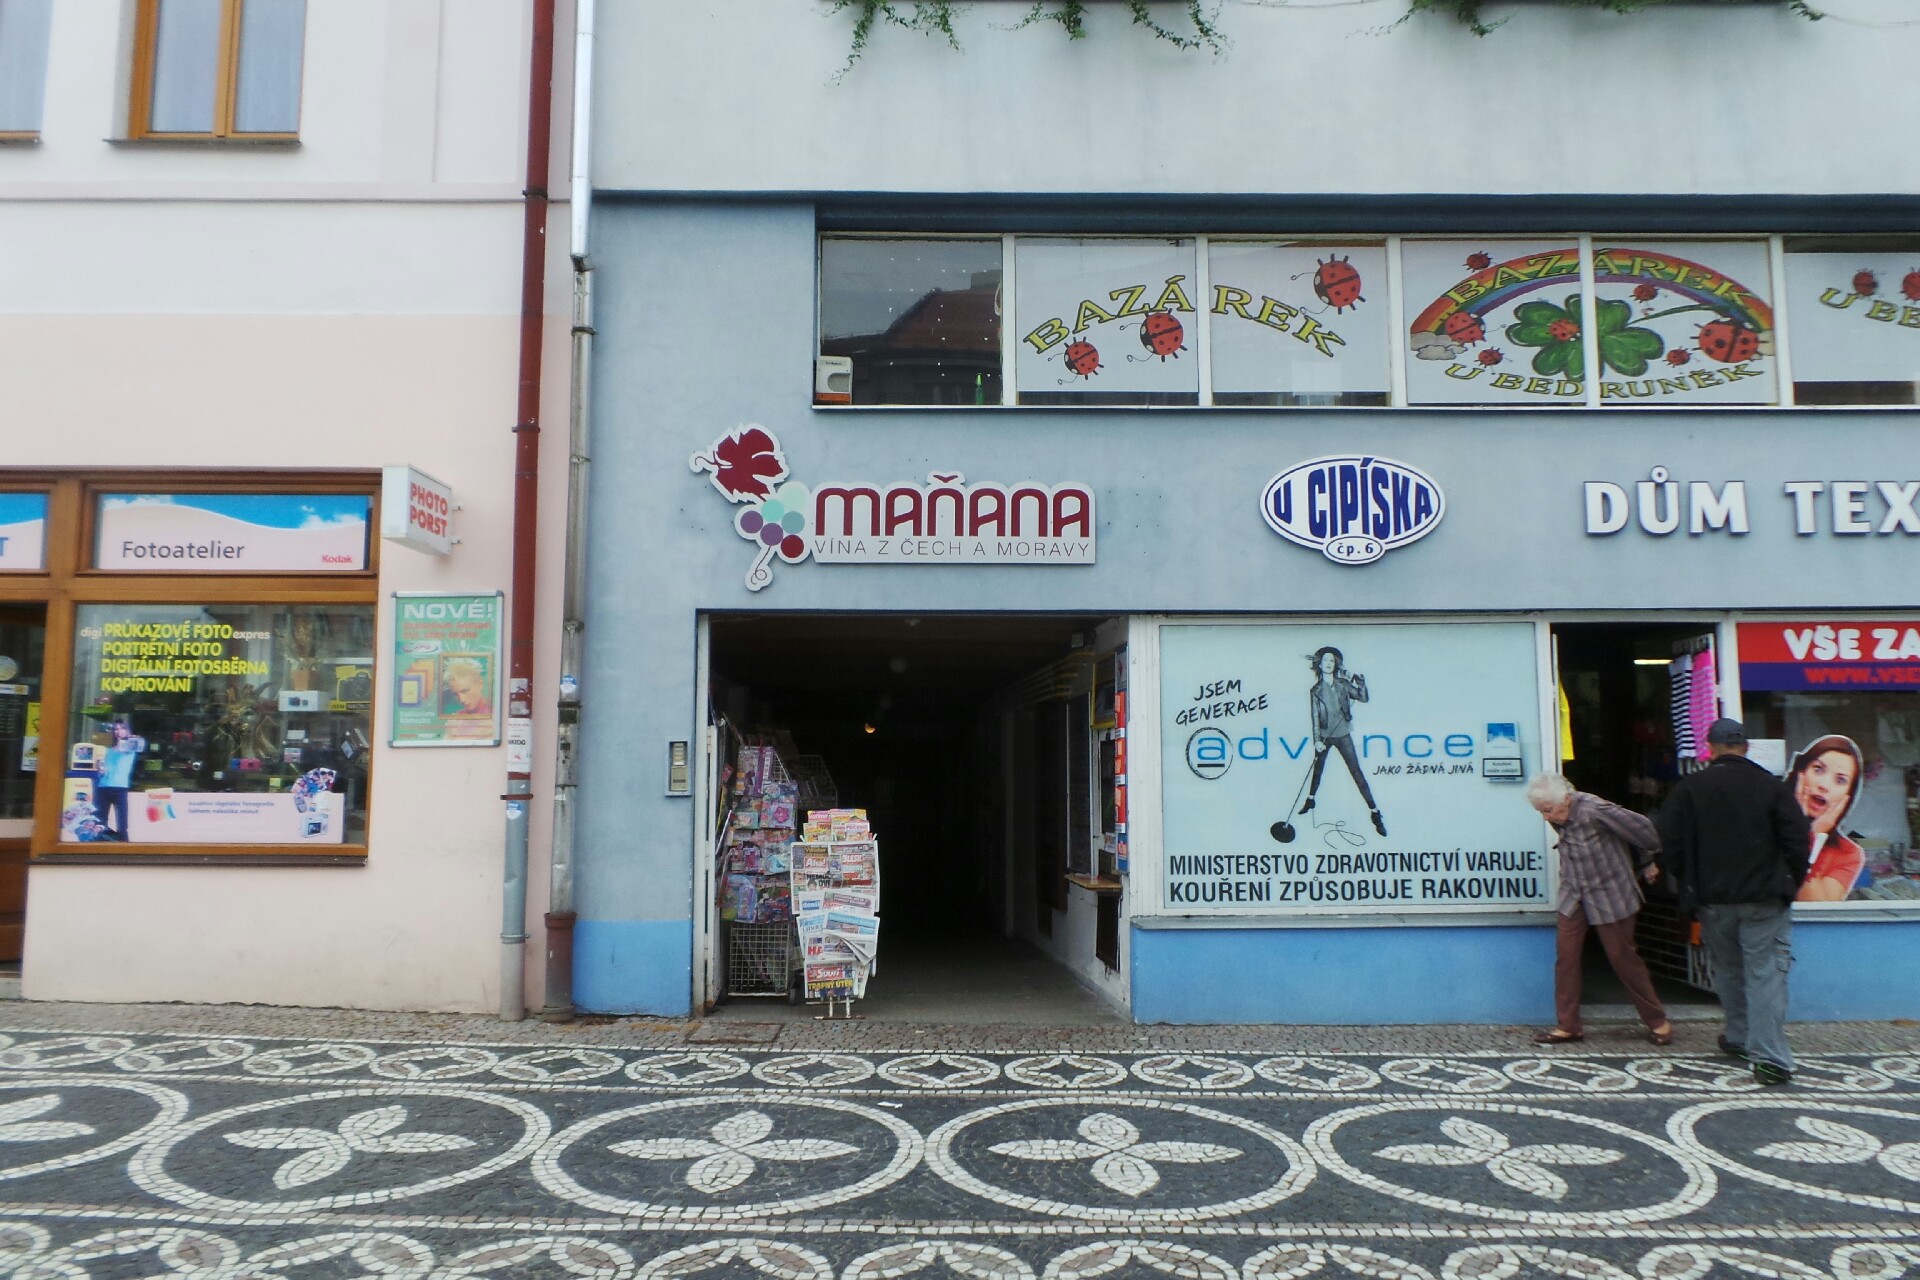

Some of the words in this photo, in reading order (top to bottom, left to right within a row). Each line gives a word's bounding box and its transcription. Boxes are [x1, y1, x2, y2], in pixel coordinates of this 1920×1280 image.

[1445, 363, 1485, 380] U
[410, 482, 448, 516] PHOTO
[1274, 479, 1292, 524] U
[1308, 457, 1433, 540] CIPÍSKA
[1583, 465, 1750, 534] DŮM
[1784, 480, 1920, 534] TEX
[410, 505, 448, 538] PORST
[122, 540, 245, 559] Fotoatelier
[815, 538, 866, 554] VÍNA
[878, 541, 889, 554] Z
[901, 538, 961, 555] ČECH
[973, 542, 986, 555] A
[998, 542, 1089, 557] MORAVY
[322, 555, 353, 563] Kodak
[404, 600, 494, 618] NOVÉ!
[104, 620, 191, 639] PRŮKAZOVÉ
[193, 624, 233, 639] FOTO
[232, 630, 271, 641] expres
[102, 638, 181, 656] PORTRÉTNÍ
[182, 642, 222, 657] FOTO
[1783, 625, 1862, 660] VŠE
[1872, 628, 1920, 660] ZA
[101, 656, 173, 673] DIGITÁLNÍ
[174, 657, 269, 675] FOTOSBĚRNA
[101, 674, 193, 692] KOPÍROVÁNÍ
[1194, 680, 1241, 701] JSEM
[1175, 694, 1269, 726] GENERACE
[1373, 764, 1402, 775] JAKO
[1406, 762, 1446, 775] ŽÁDNÁ
[1448, 762, 1474, 775] JINÁ
[1170, 855, 1308, 875] MINISTERSTVO
[1316, 848, 1460, 874] ZDRAVOTNICTVÍ
[1465, 851, 1543, 872] VARUJE:
[1170, 877, 1271, 902] KOUŘENÍ
[1280, 876, 1413, 901] ZPŮSOBUJE
[1422, 878, 1543, 899] RAKOVINU.
